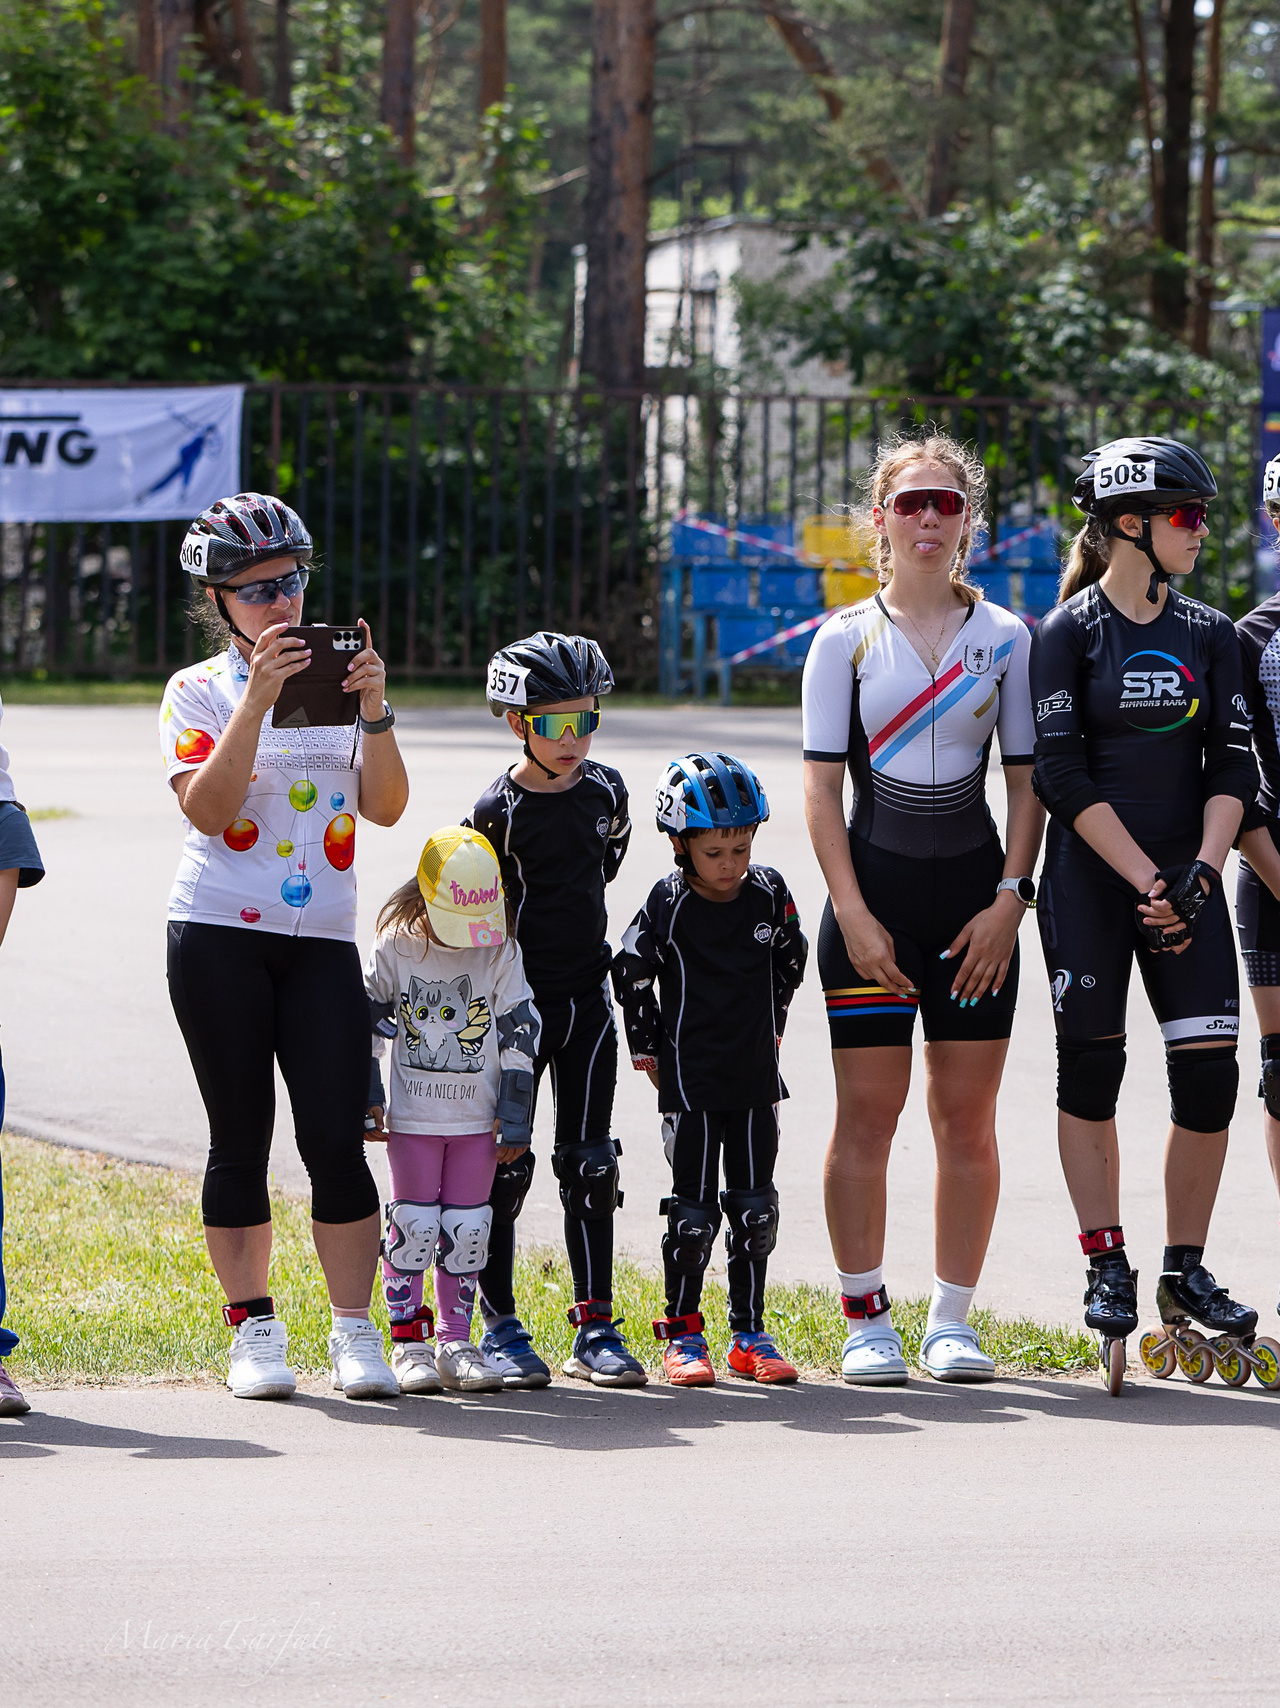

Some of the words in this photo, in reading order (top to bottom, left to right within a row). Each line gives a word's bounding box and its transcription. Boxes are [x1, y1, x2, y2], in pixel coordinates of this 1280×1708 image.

[1100, 464, 1147, 489] 508
[490, 668, 520, 696] 357
[1120, 671, 1184, 699] SR
[449, 875, 499, 906] travel
[425, 1083, 432, 1098] A
[434, 1083, 458, 1100] NICE
[460, 1084, 478, 1100] DAY
